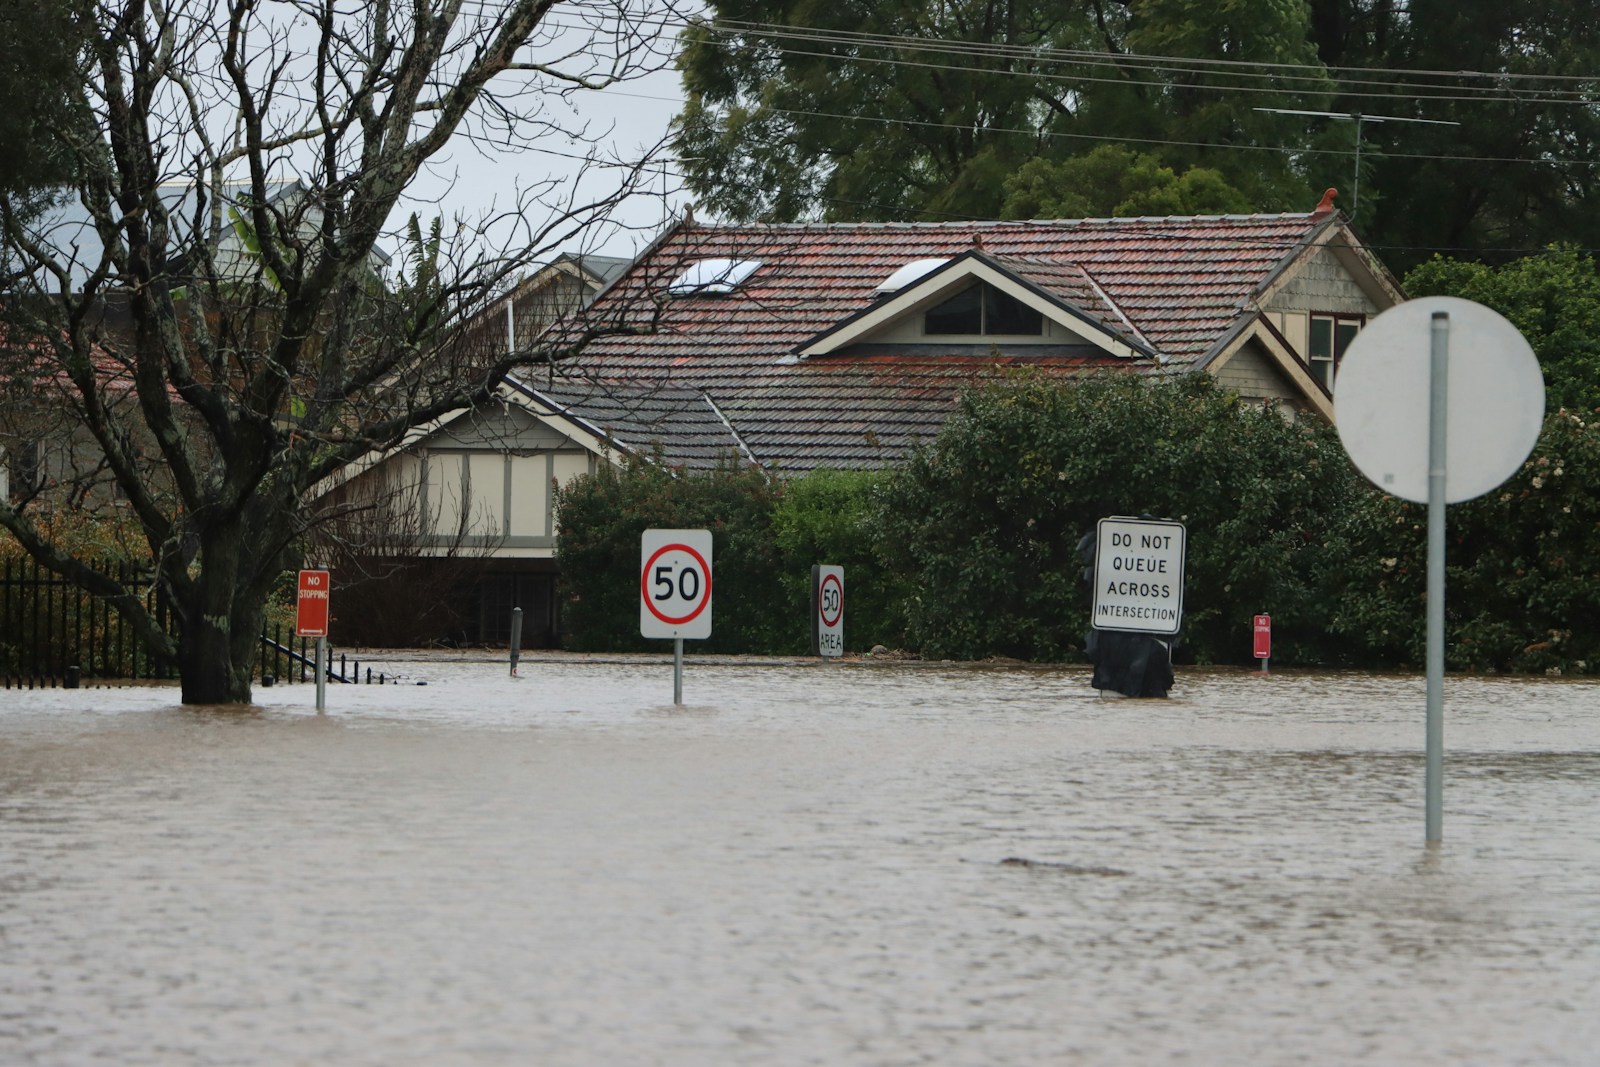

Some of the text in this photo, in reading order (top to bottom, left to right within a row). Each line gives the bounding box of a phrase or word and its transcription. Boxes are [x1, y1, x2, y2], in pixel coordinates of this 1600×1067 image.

[1112, 533, 1171, 549] DO NOT
[1113, 557, 1167, 573] QUEUE
[307, 576, 320, 586] NO
[655, 566, 699, 601] 50
[300, 589, 328, 599] STOPPING
[1107, 581, 1170, 598] ACROSS
[823, 589, 839, 612] 50
[1098, 604, 1176, 620] INTERSECTION
[820, 633, 842, 649] AREA
